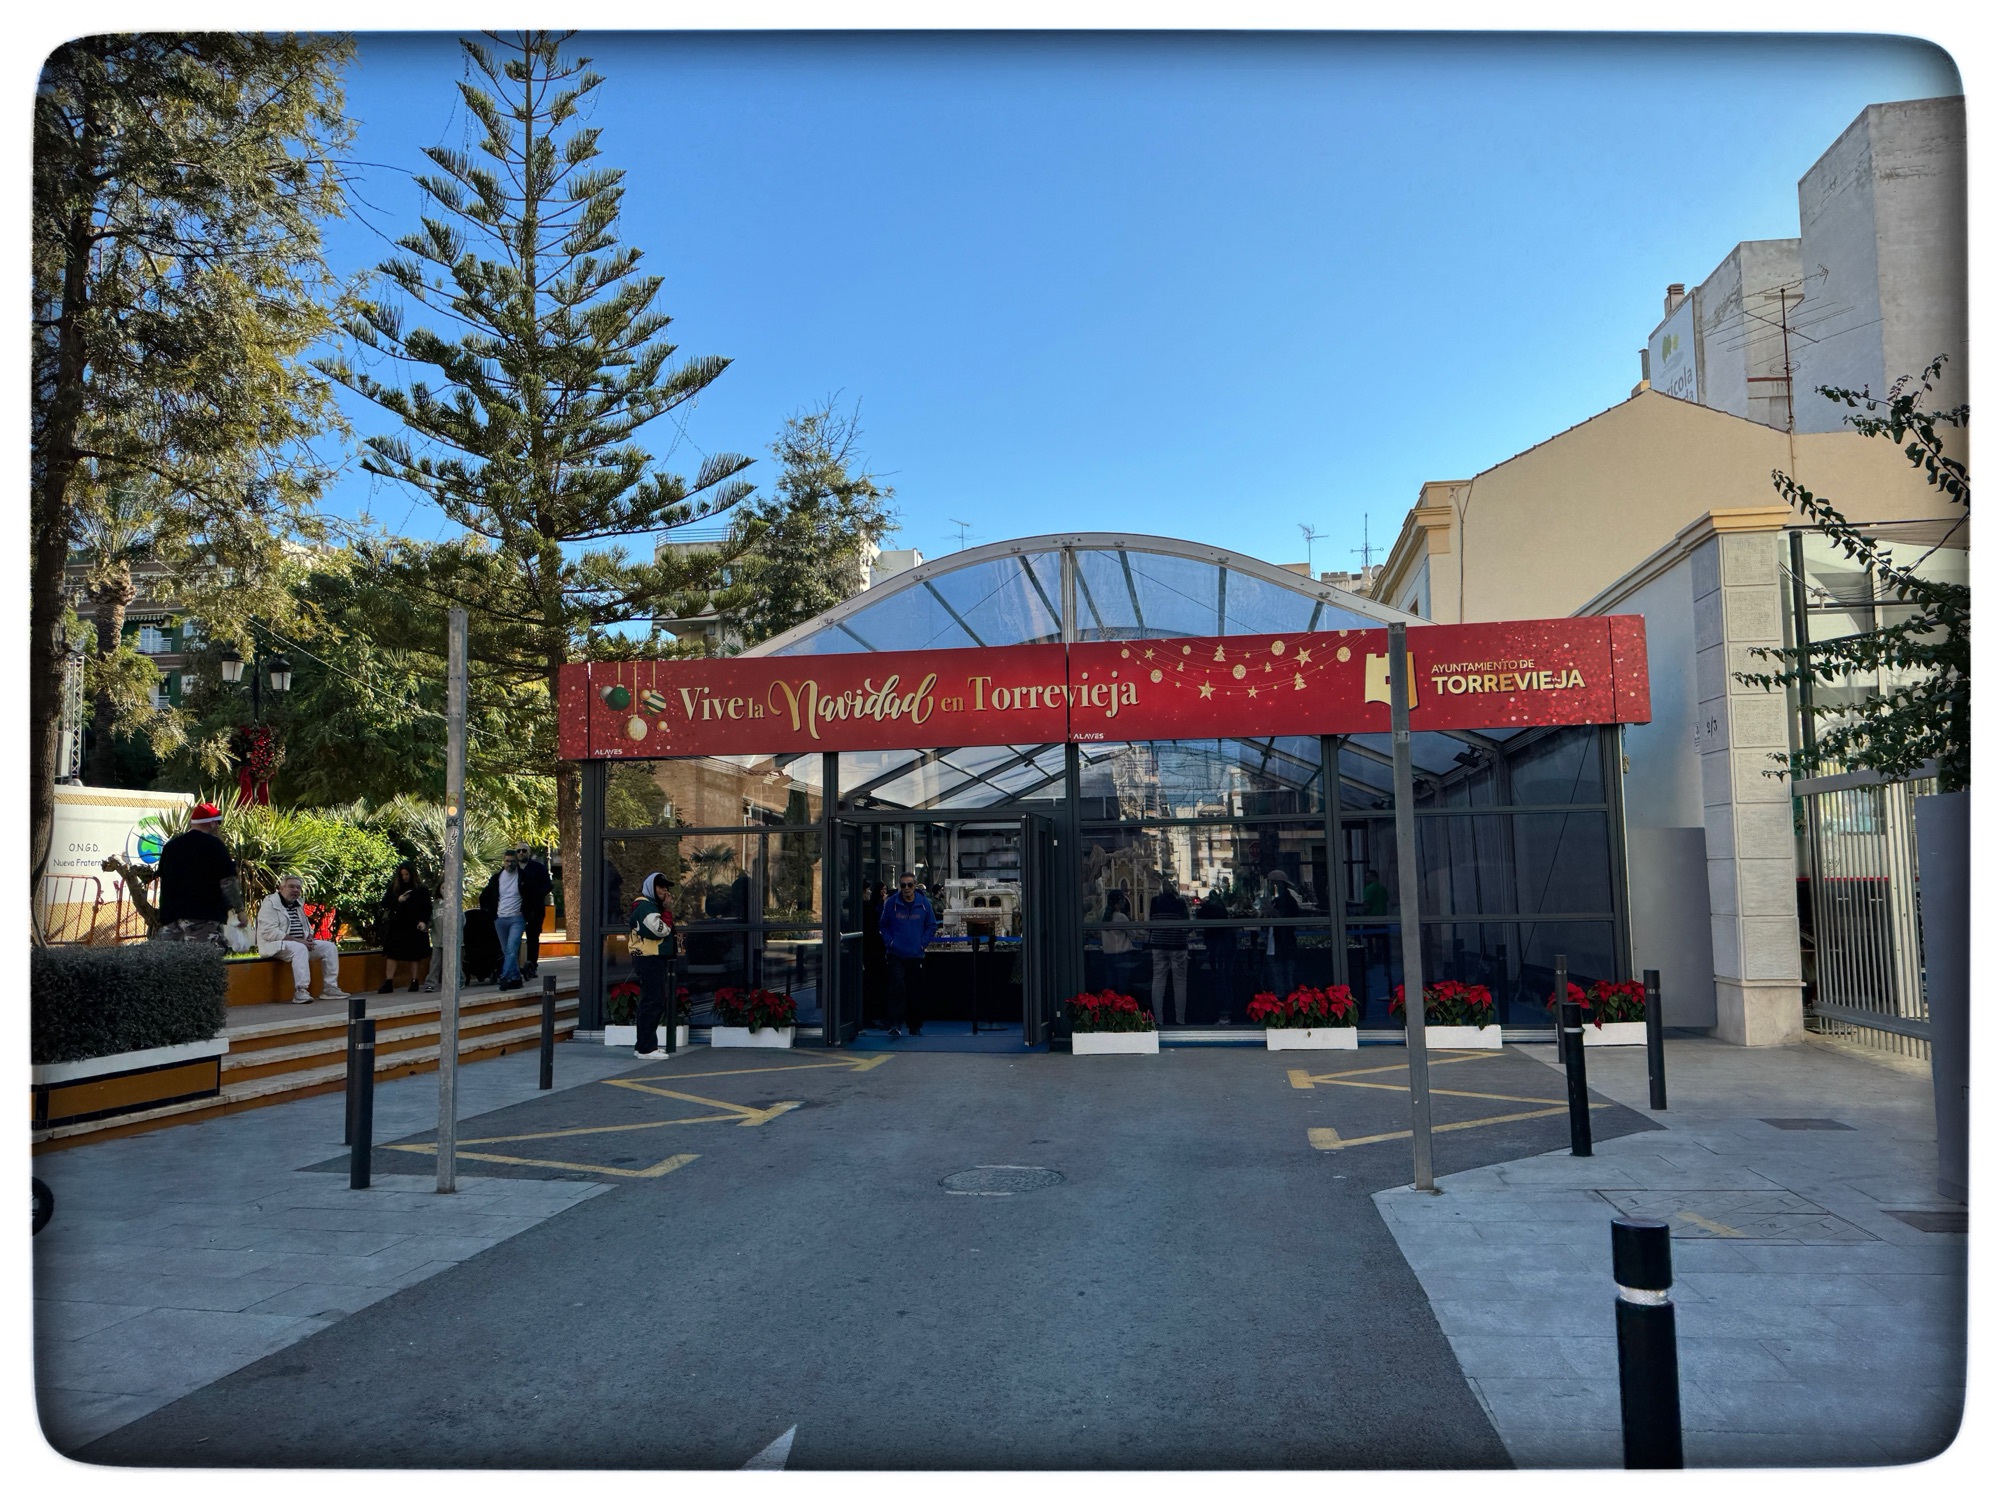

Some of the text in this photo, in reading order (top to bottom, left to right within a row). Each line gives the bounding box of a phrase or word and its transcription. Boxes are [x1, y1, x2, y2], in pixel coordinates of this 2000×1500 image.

[1431, 659, 1535, 674] AYUNTAMIENTO DE
[1431, 669, 1586, 695] TORREVIEJA
[677, 670, 1140, 740] Vive la Navidad en Torrevieja
[1073, 732, 1104, 740] ALAVES
[53, 858, 75, 867] Nueva
